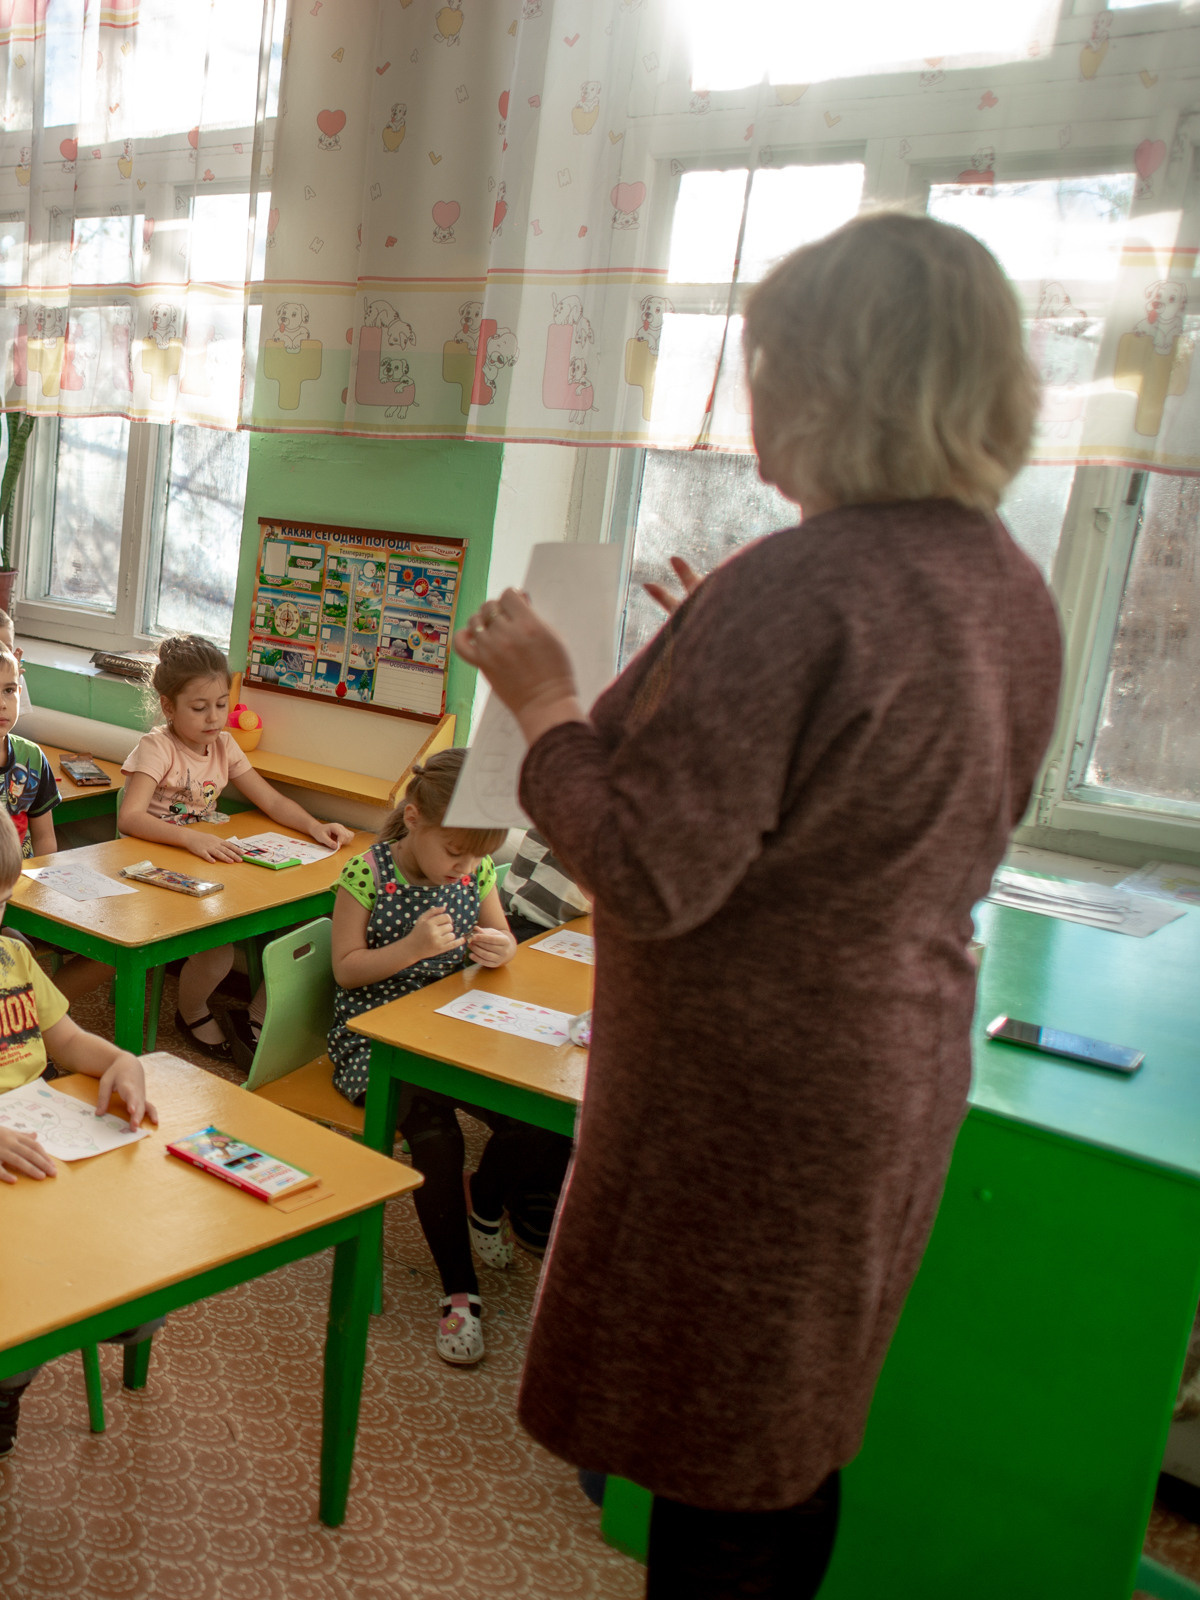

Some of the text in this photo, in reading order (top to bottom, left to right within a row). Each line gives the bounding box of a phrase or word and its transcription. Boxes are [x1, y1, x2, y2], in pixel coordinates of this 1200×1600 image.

[280, 527, 412, 551] КАКАЯ СЕГОДНЯ ПОГОДА
[339, 548, 375, 560] Температура
[407, 556, 441, 567] Облачность
[408, 610, 430, 620] Осадки
